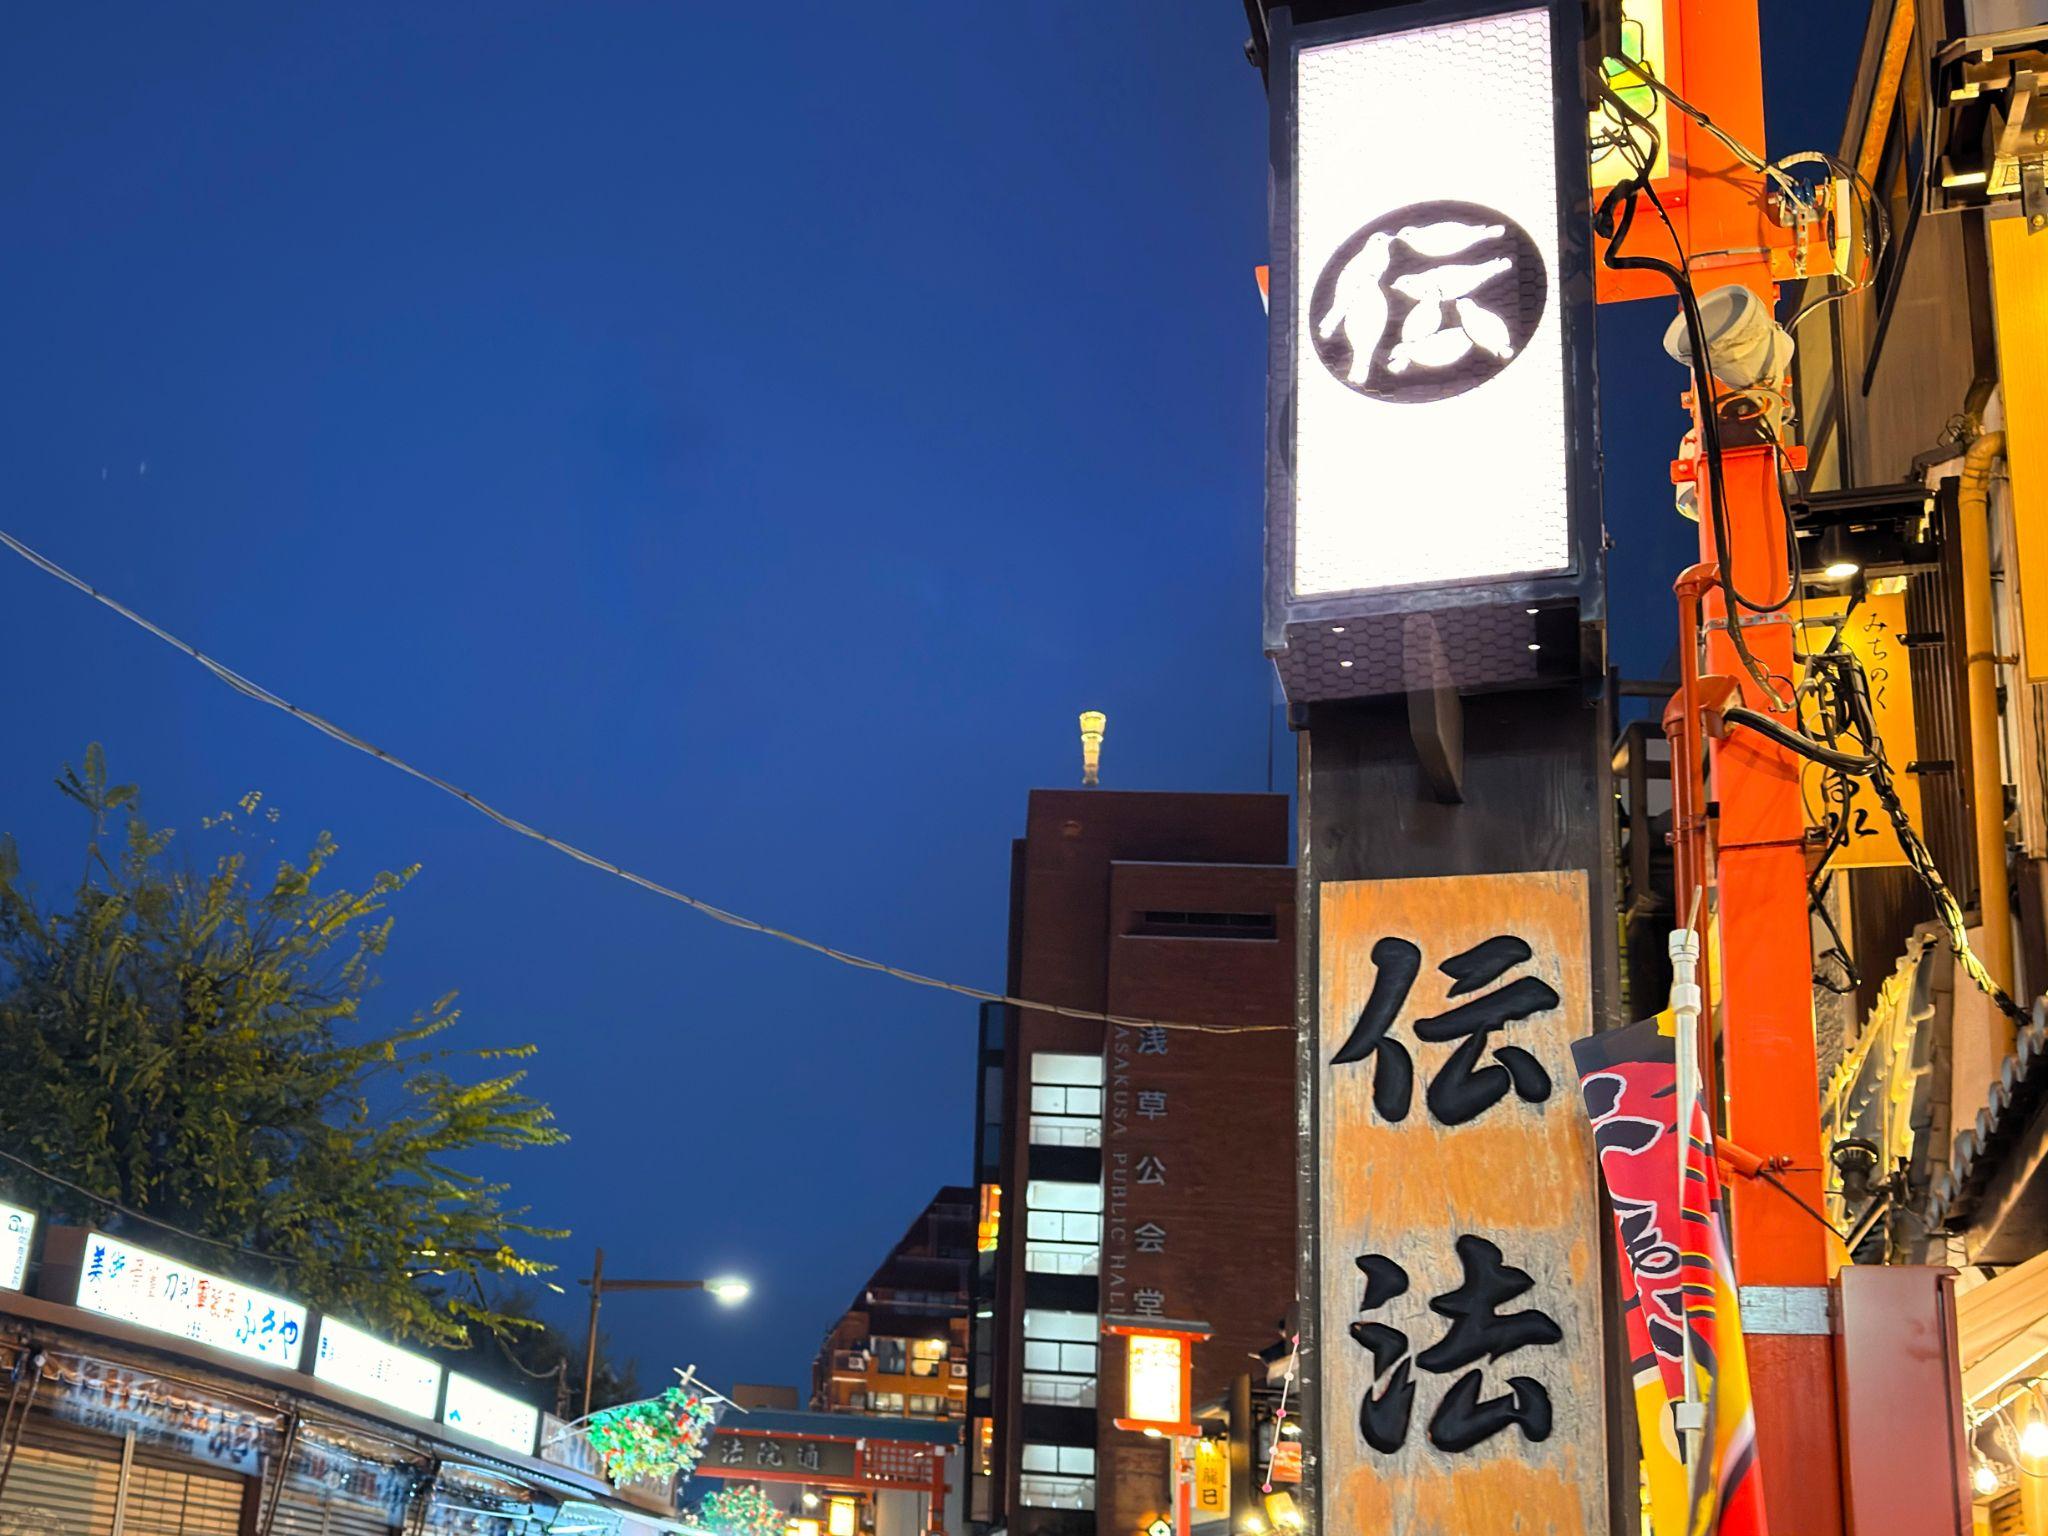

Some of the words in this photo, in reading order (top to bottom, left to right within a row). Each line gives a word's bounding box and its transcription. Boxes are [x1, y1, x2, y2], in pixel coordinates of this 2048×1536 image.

[1318, 222, 1514, 384] 伝
[1863, 613, 1888, 710] みちのく
[1112, 1026, 1130, 1136] ASAKUSA
[1110, 1153, 1127, 1240] PUBLIC
[1133, 1025, 1169, 1318] 浅草公会堂
[1329, 935, 1563, 1454] 伝法
